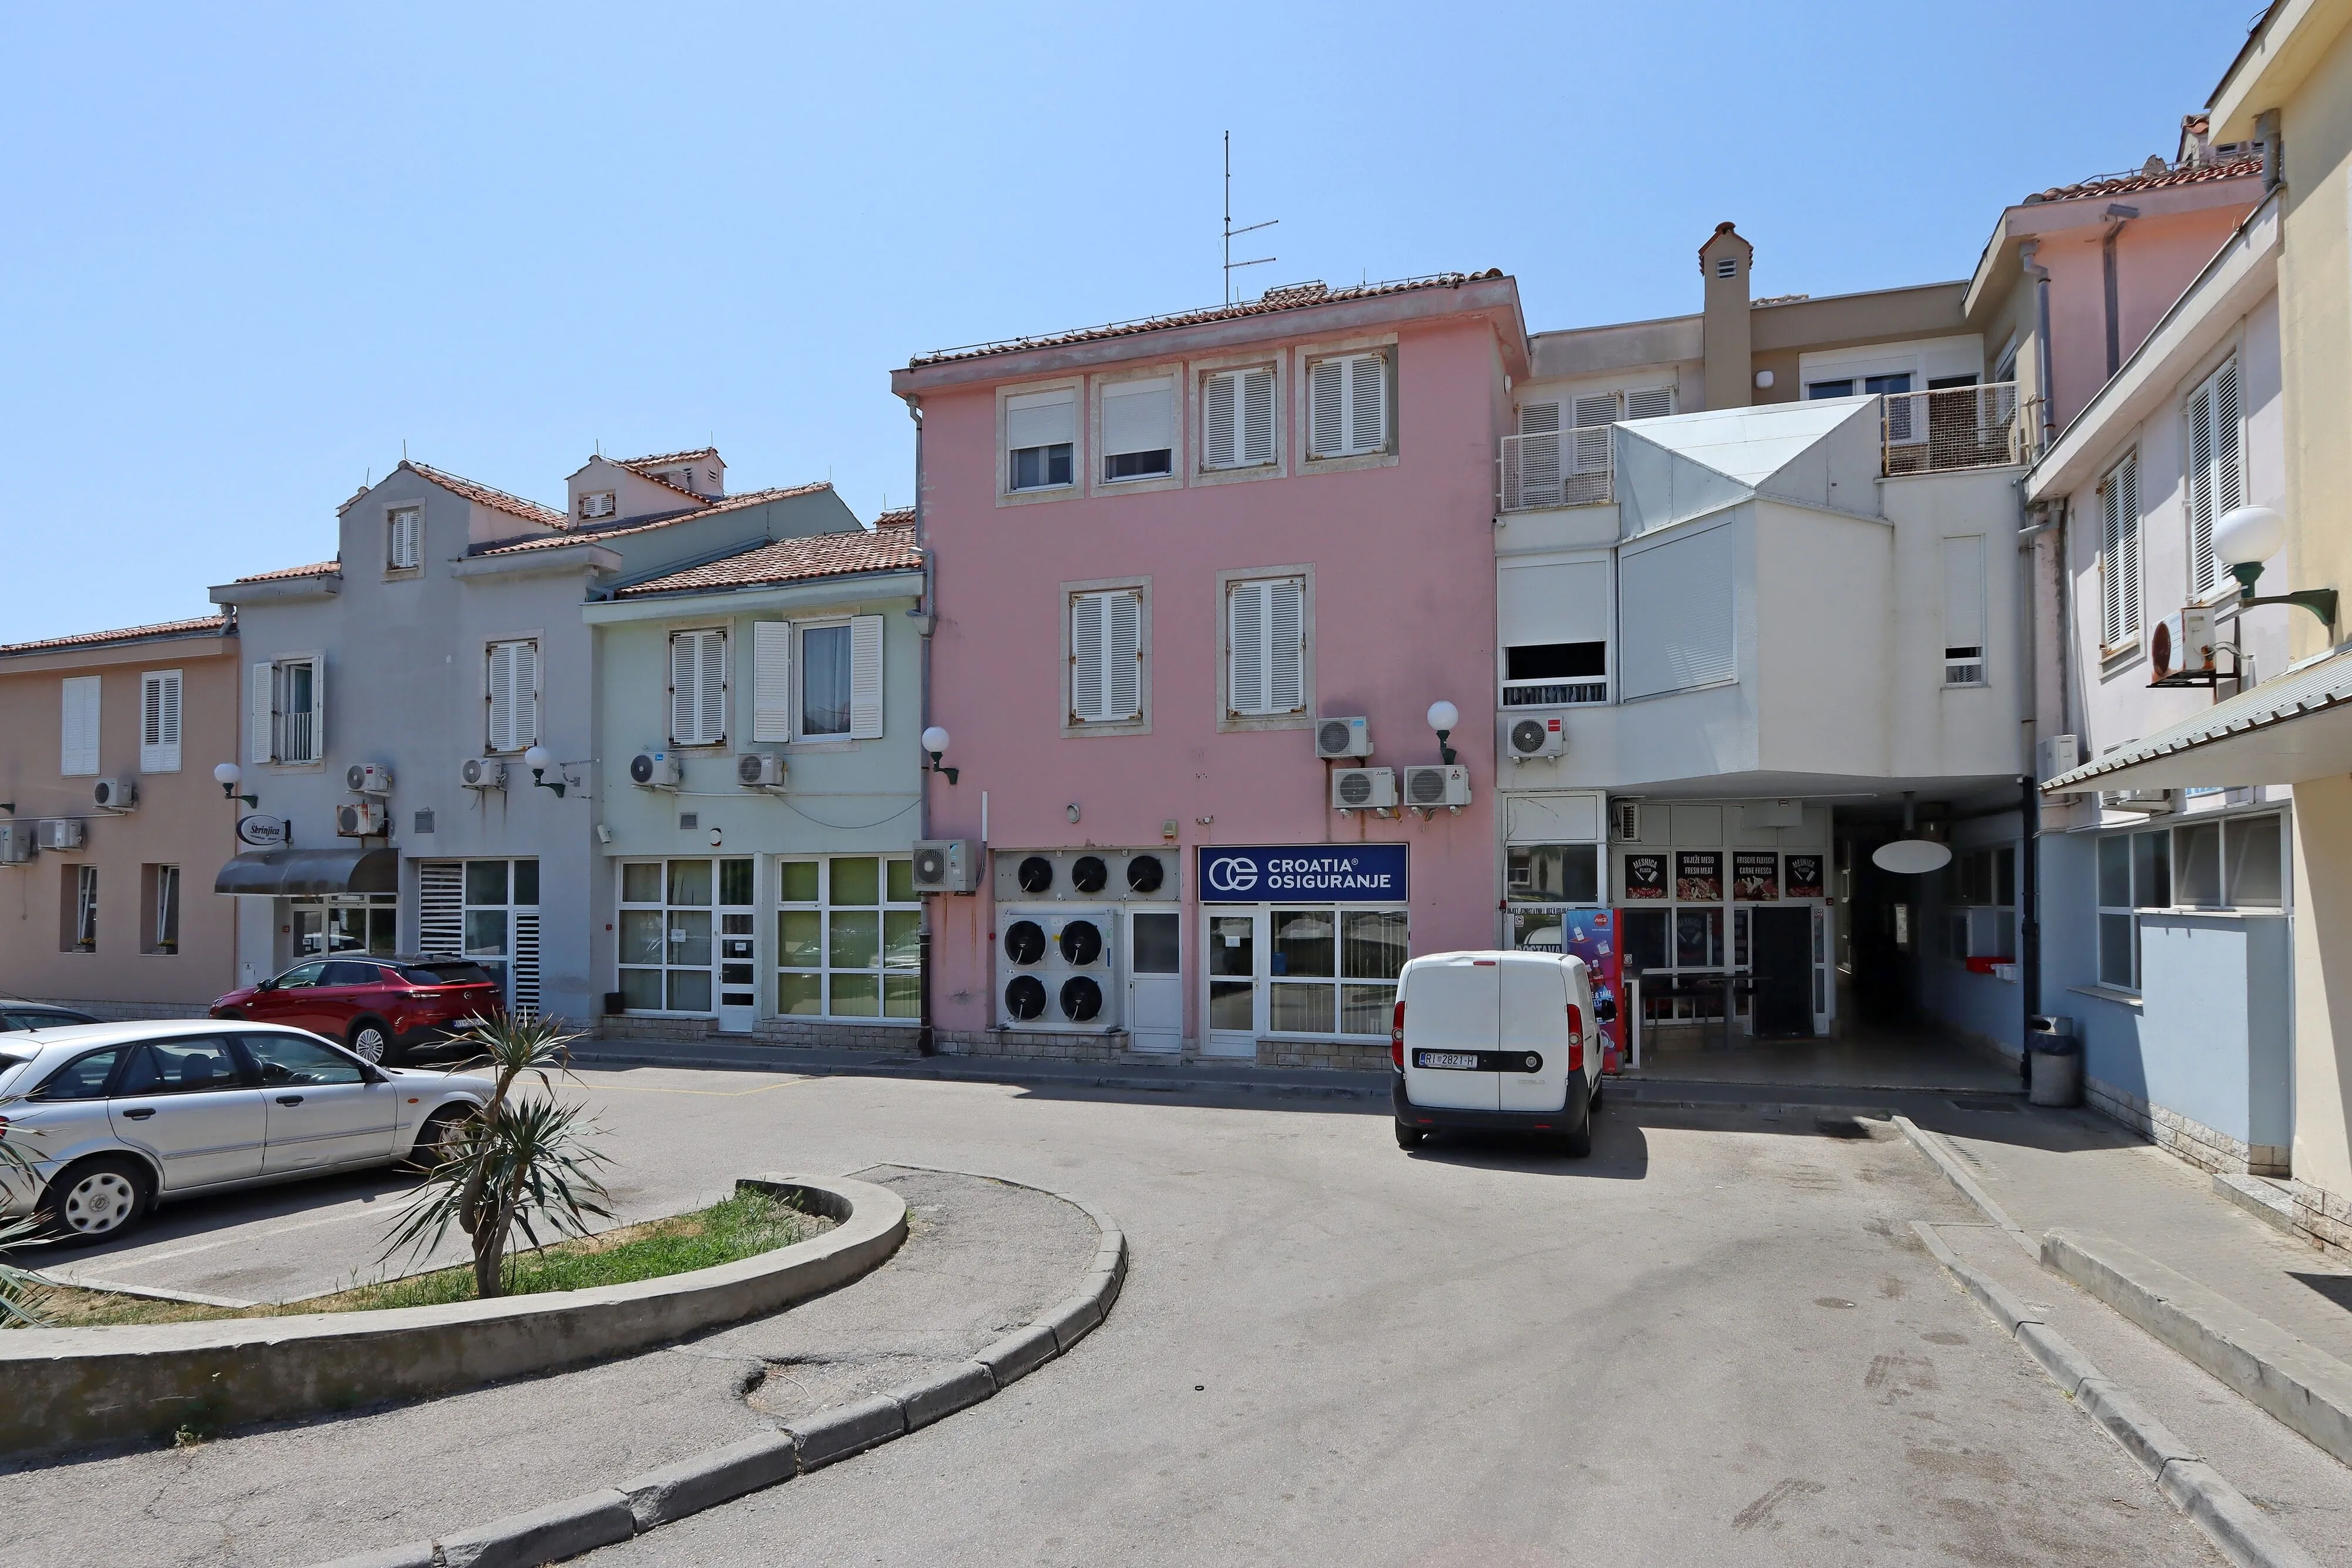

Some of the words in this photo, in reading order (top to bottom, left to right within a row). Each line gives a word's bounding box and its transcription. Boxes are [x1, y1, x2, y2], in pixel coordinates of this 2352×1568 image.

[1633, 858, 1658, 870] MESNICA
[1683, 855, 1700, 864] SVJEŽE
[1792, 858, 1815, 868] MESNICA
[1268, 874, 1391, 889] OSIGURANJE
